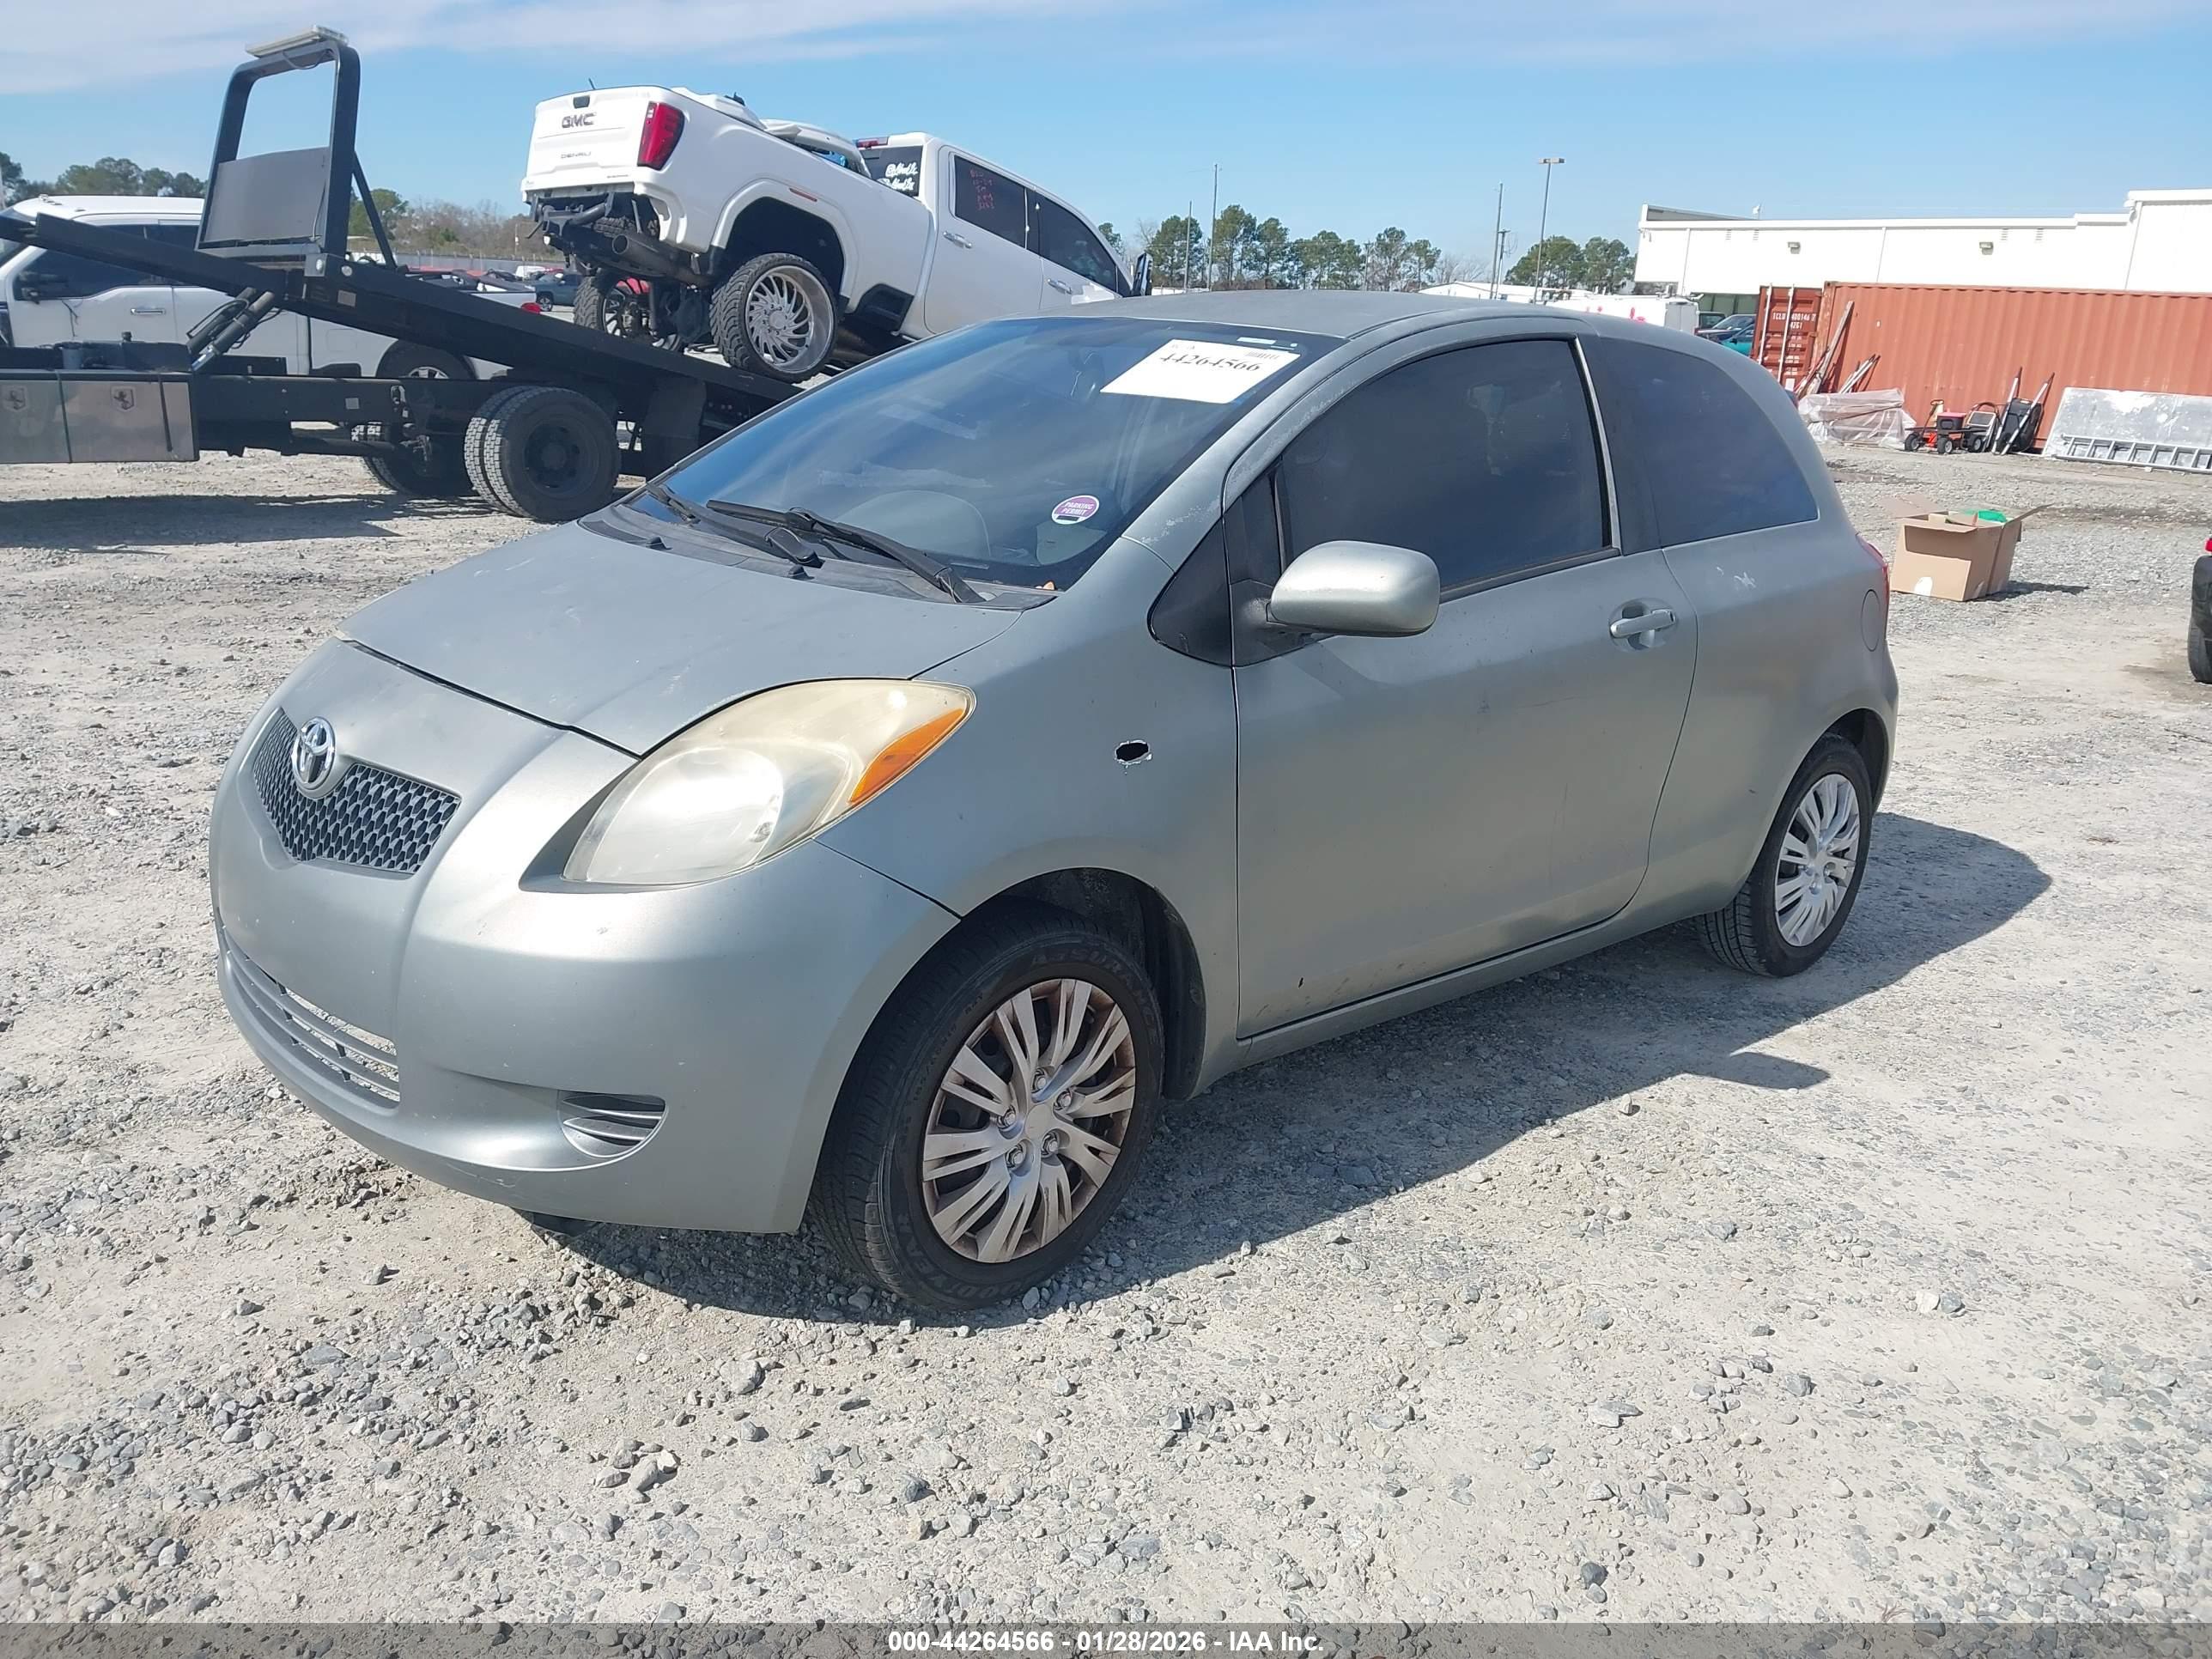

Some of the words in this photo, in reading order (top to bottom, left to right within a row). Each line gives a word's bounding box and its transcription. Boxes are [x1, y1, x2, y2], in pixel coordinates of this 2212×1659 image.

[562, 112, 597, 128] GMC
[1159, 353, 1260, 372] 44264566
[1062, 501, 1095, 510] PARKING
